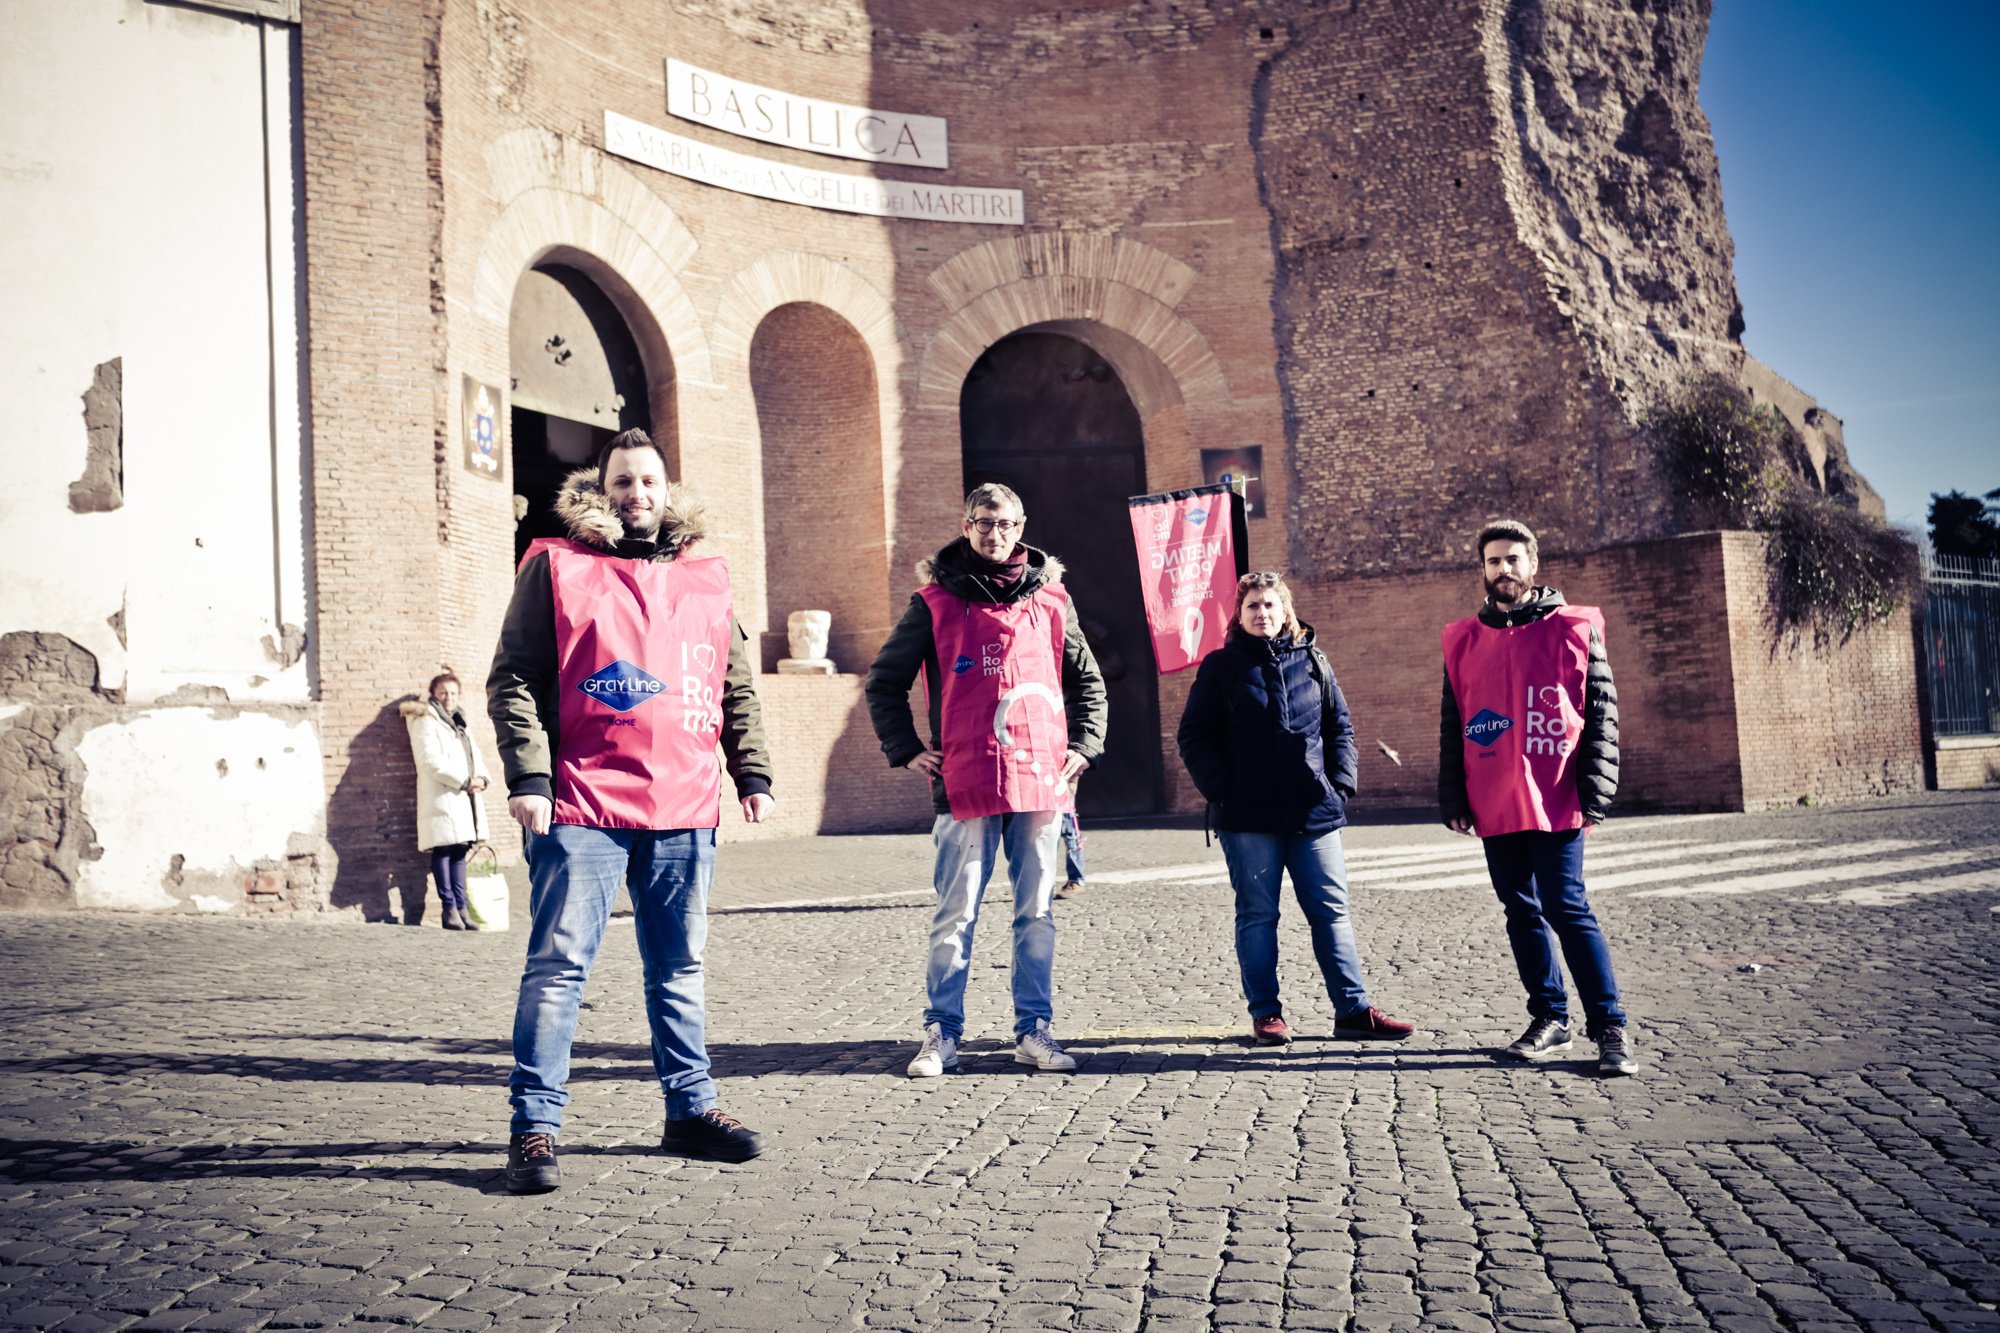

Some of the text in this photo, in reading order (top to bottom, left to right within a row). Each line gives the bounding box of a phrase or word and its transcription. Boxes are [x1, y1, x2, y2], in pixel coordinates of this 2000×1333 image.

[691, 73, 922, 159] BASILICA
[636, 129, 707, 174] MARIA
[765, 169, 857, 206] ANGELI
[880, 195, 905, 211] DEI
[911, 189, 1014, 218] MARTIRI
[681, 641, 688, 672] I
[982, 645, 986, 656] I
[982, 656, 1001, 667] Ro
[983, 665, 1005, 677] me
[583, 678, 661, 693] Gray Line
[682, 675, 714, 707] Ro
[1528, 686, 1533, 708] I
[607, 718, 636, 727] ROME
[683, 708, 720, 734] me
[1464, 719, 1510, 736] Gray Line
[1526, 711, 1567, 736] Ro
[1526, 736, 1574, 757] me
